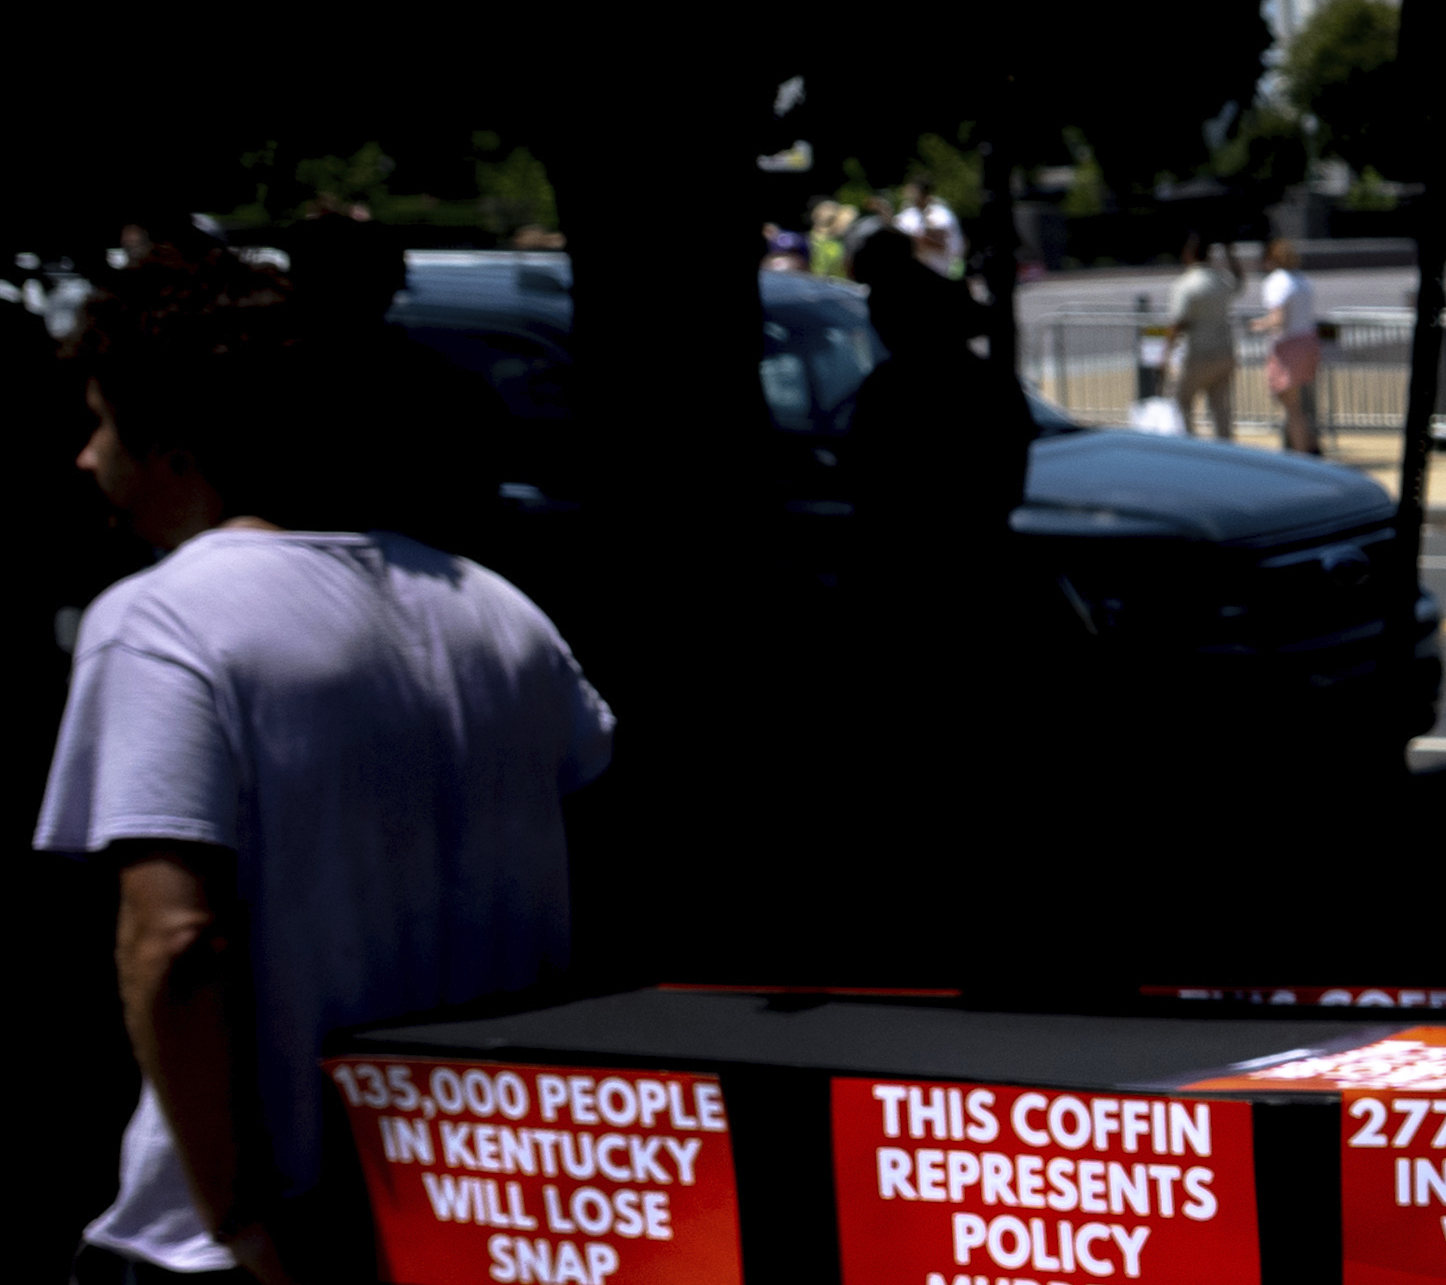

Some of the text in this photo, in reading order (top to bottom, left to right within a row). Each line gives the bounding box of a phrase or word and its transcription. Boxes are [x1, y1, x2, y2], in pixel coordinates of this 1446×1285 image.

[335, 1065, 727, 1132] 135,000 PEOPLE
[872, 1084, 1211, 1157] THIS COFFIN
[382, 1117, 701, 1186] IN KENTUCKY
[877, 1147, 1217, 1220] REPRESENTS
[423, 1173, 673, 1241] WILL LOSE
[952, 1212, 1150, 1278] POLICY
